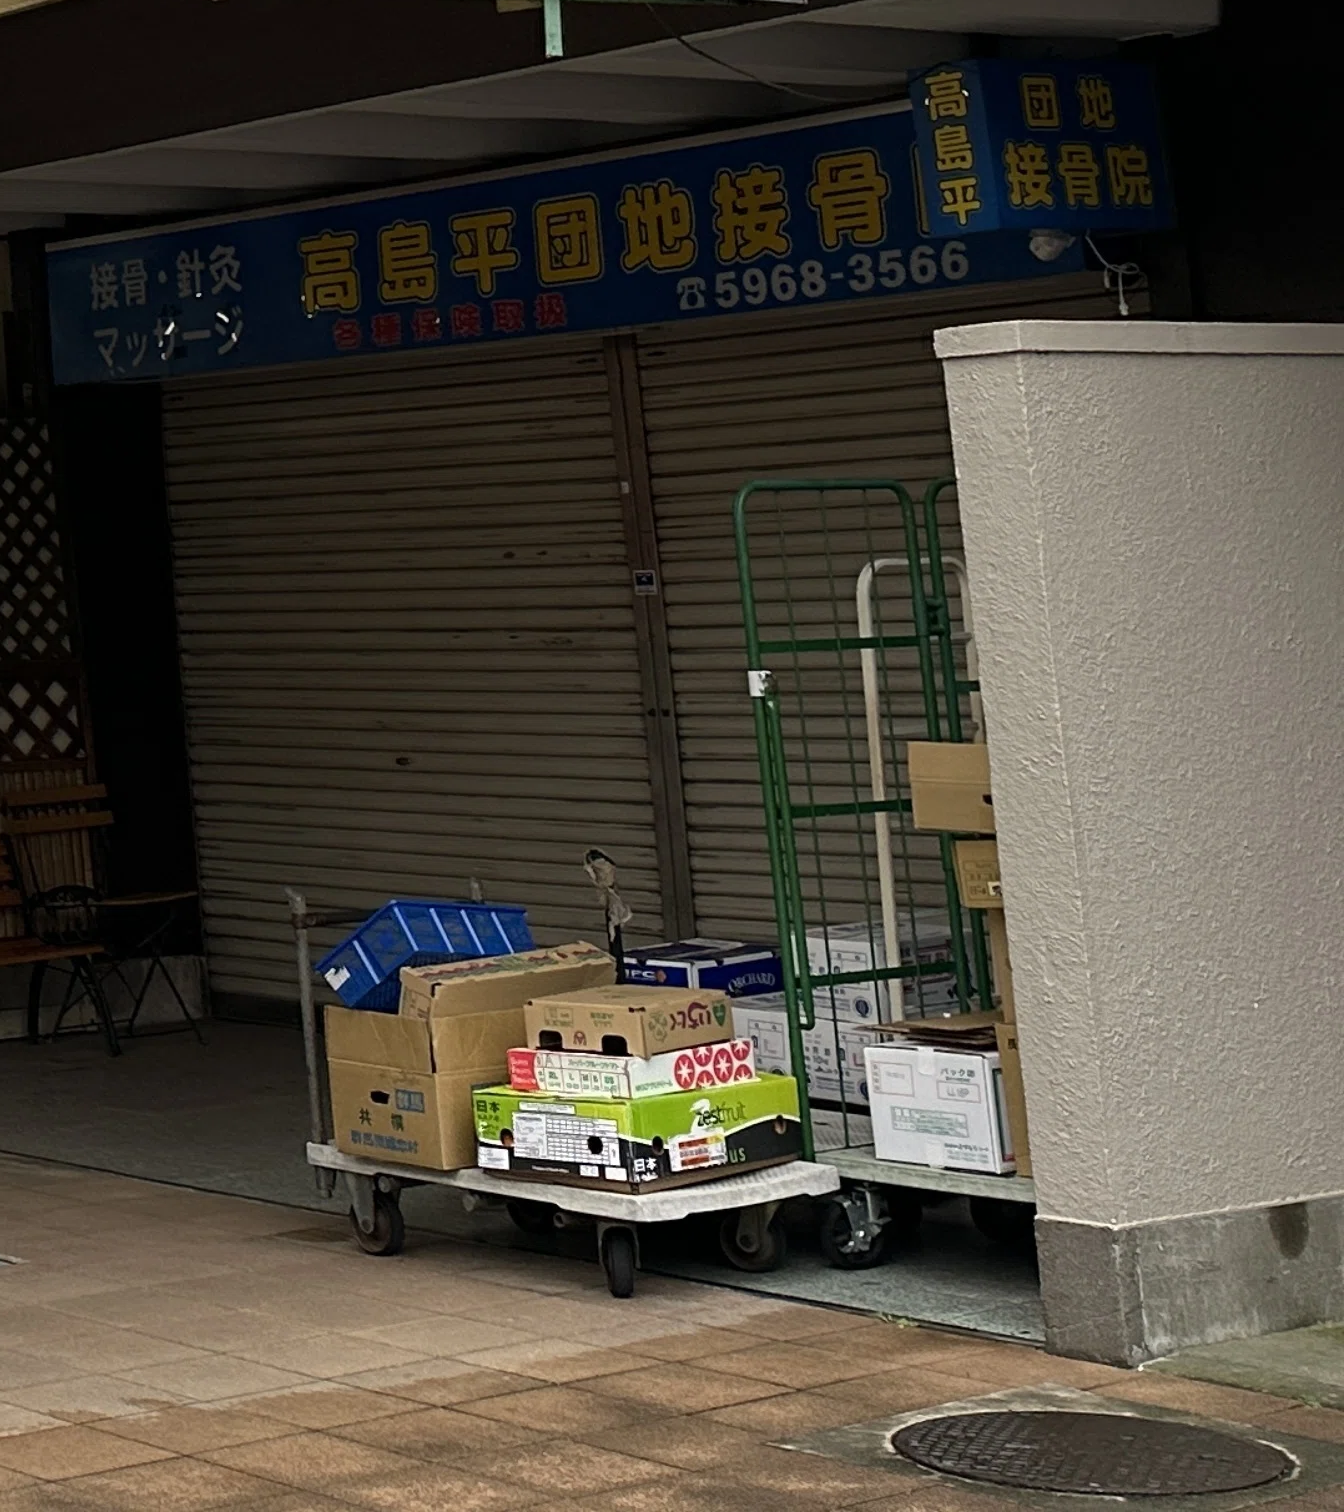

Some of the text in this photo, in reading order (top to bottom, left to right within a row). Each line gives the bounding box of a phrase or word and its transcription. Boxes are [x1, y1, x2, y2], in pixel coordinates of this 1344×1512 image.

[1020, 74, 1116, 130] 団地
[924, 71, 982, 226] 高島平
[1004, 142, 1153, 210] 接骨院
[298, 141, 929, 316] 高島平団地接骨
[713, 240, 970, 308] 5968-3566
[333, 292, 567, 349] 各種保険取扱
